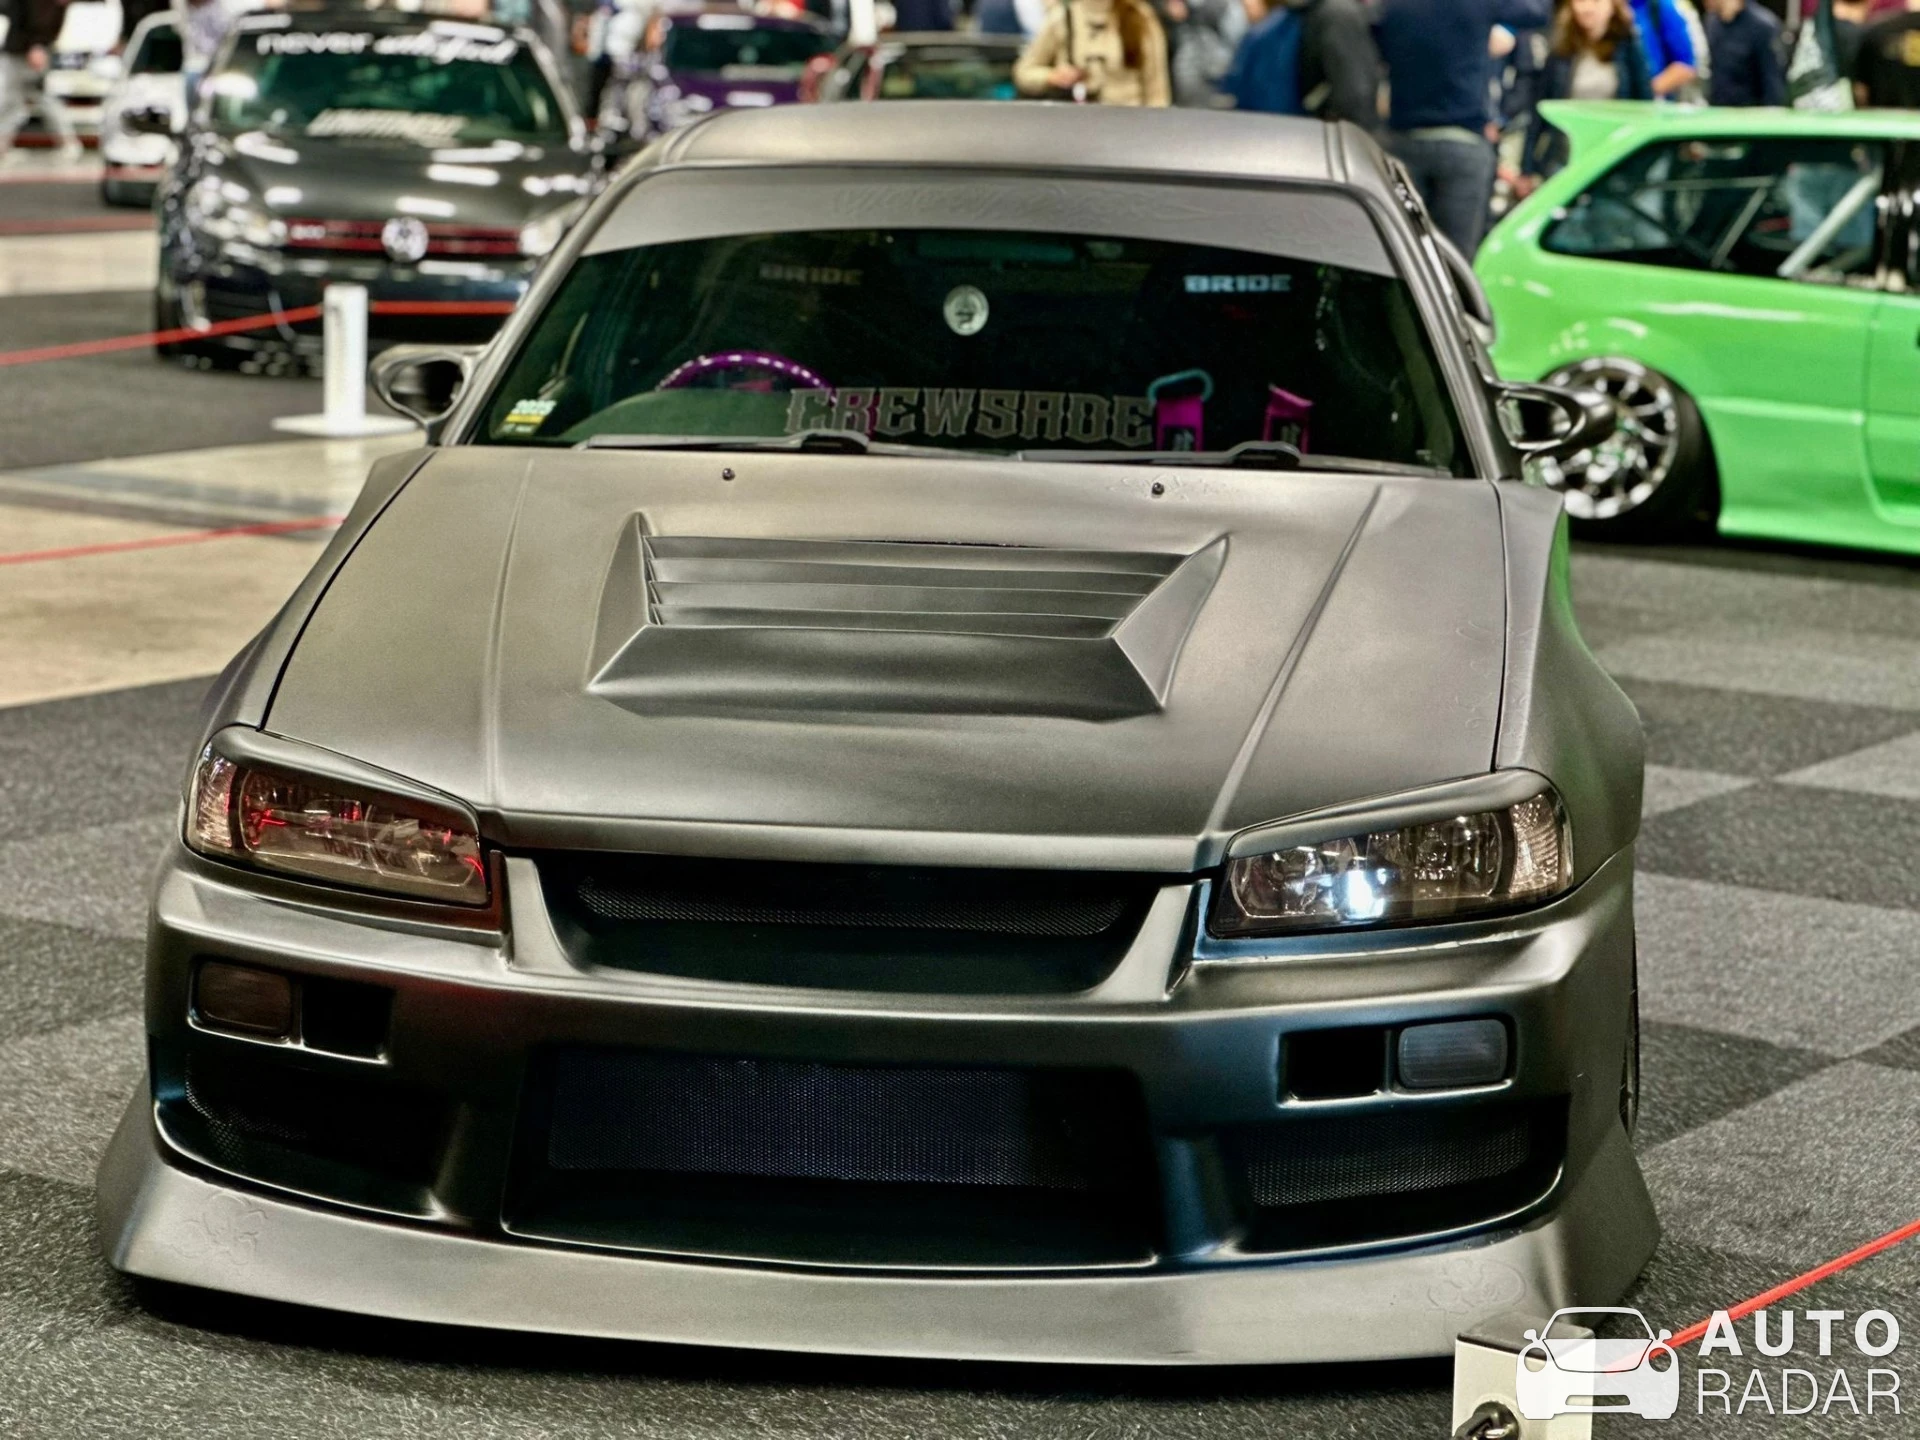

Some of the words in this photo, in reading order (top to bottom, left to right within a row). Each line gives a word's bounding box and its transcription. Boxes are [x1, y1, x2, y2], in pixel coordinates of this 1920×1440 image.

[257, 33, 373, 55] never
[759, 264, 863, 285] BRIDE
[1184, 274, 1291, 293] BRIDE
[785, 388, 1154, 444] CREWSADE
